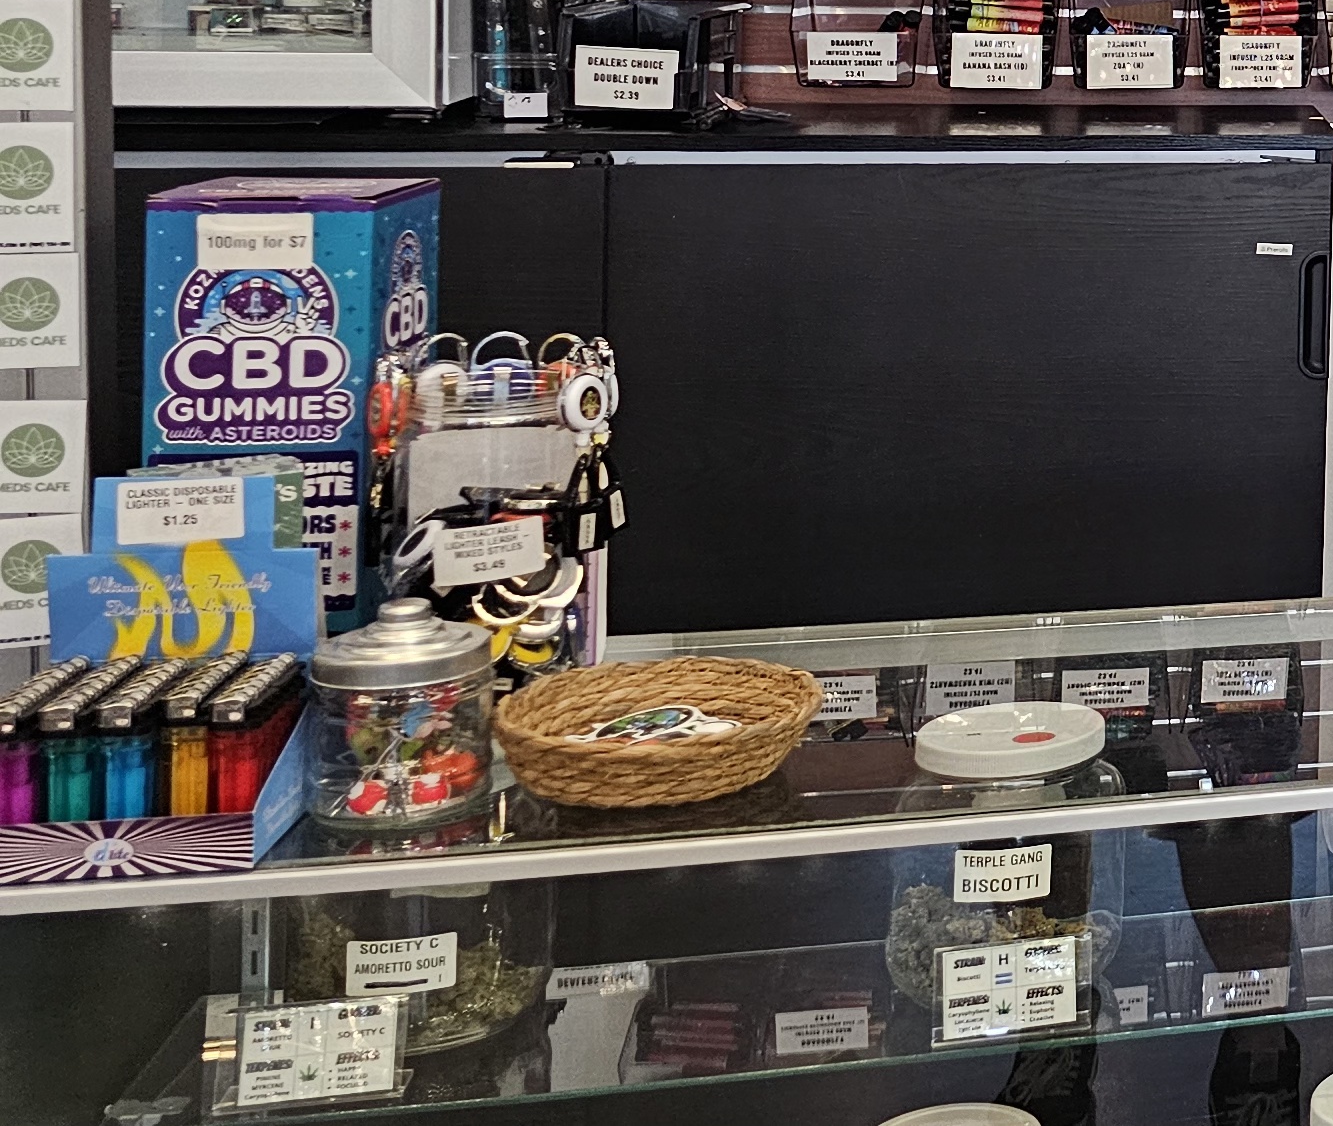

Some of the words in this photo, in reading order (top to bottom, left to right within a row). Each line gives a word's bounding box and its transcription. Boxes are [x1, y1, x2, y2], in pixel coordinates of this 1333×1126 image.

[830, 39, 874, 48] DRAGONFLY
[587, 56, 629, 69] DEALERS
[630, 59, 664, 70] CHOICE
[809, 59, 852, 68] BLACKBERRY
[962, 61, 992, 71] BANANA
[993, 61, 1012, 71] BASH
[593, 72, 629, 84] DOUBLE
[631, 74, 659, 86] DOWN
[845, 70, 866, 78] $3.41
[613, 90, 640, 101] $2.39
[206, 234, 258, 252] 100mg
[262, 234, 283, 248] for
[288, 233, 309, 250] $7
[385, 284, 429, 348] CBD
[173, 338, 344, 390] CBD
[166, 393, 351, 422] GUMMIES
[166, 424, 206, 441] with
[209, 424, 338, 441] ASTEROIDS
[127, 485, 172, 499] CLASSIC
[173, 483, 237, 497] DISPOSABLE
[125, 496, 171, 511] LIGHTER
[189, 495, 210, 508] ONE
[213, 494, 236, 506] SIZE
[162, 513, 199, 526] $1.25
[453, 523, 521, 541] RETRACTABLE
[444, 537, 485, 550] LIGHTER
[486, 533, 519, 546] LEASH
[453, 546, 487, 560] MIXED
[489, 542, 524, 556] STYLES
[87, 574, 155, 594] Ultimate
[205, 572, 272, 593] Friendly
[962, 853, 1006, 868] TERPLE
[1010, 850, 1044, 866] GANG
[961, 874, 1040, 894] BISCOTTI
[360, 940, 423, 955] SOCIETY
[429, 937, 439, 949] C
[354, 960, 412, 975] AMORETTO
[416, 955, 446, 970] SOUR
